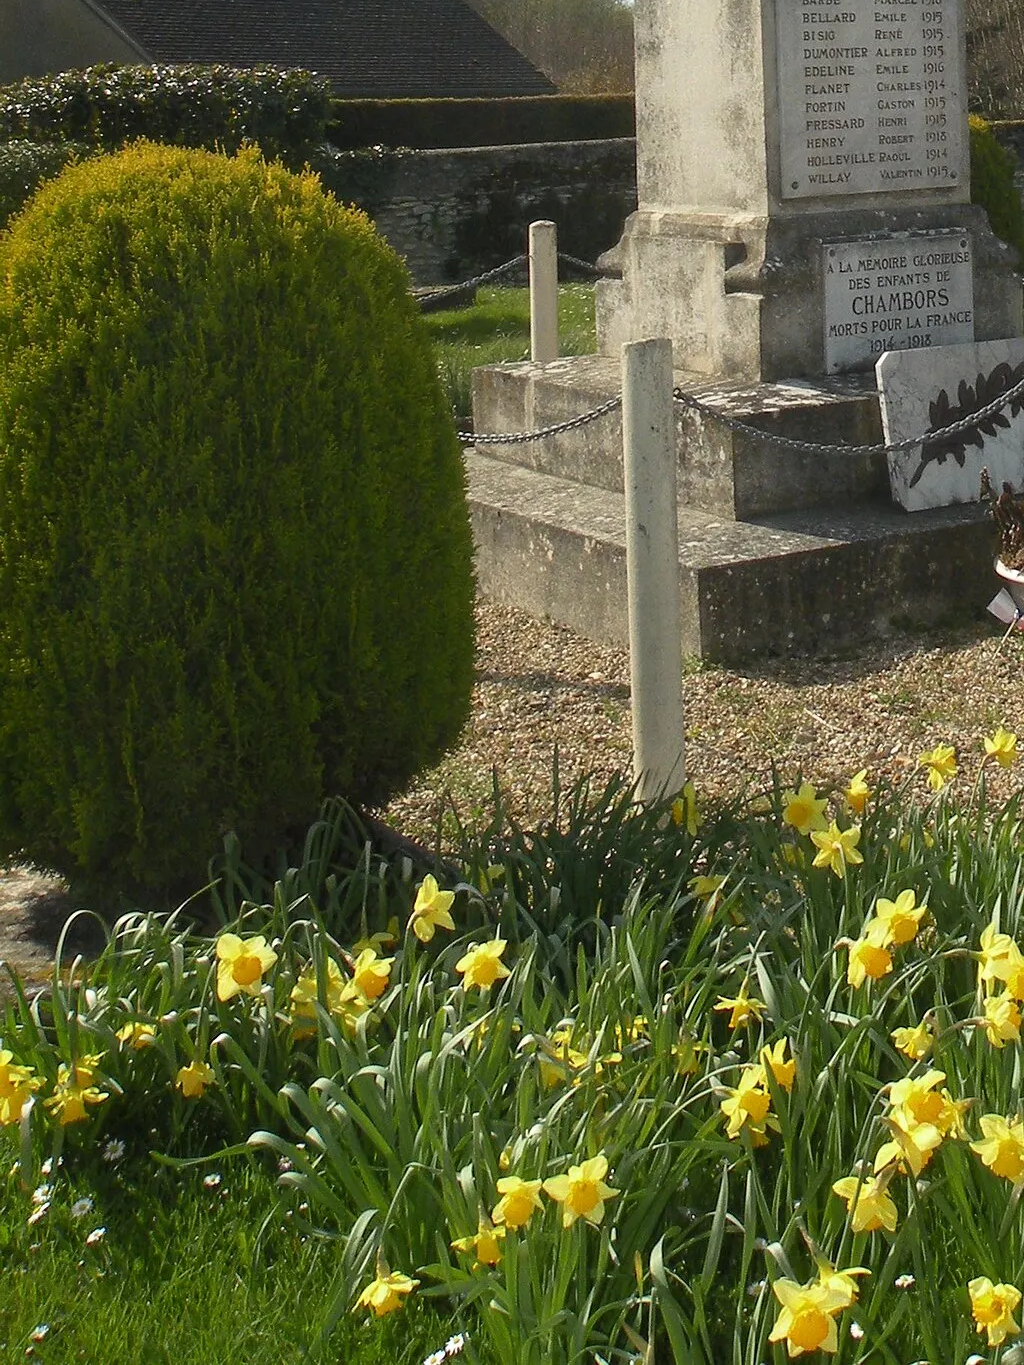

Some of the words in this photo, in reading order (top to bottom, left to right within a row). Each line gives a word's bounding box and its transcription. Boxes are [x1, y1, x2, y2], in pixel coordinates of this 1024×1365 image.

[802, 13, 856, 23] BELLARD
[922, 12, 942, 23] 1915
[922, 29, 943, 40] 1915
[804, 48, 868, 59] DUMONTIER
[923, 46, 944, 57] 1915
[805, 66, 855, 77] EDELINE
[923, 63, 944, 73] 1916
[924, 80, 945, 91] 1914
[806, 102, 846, 113] FORTIN
[924, 97, 945, 109] 1915
[806, 119, 865, 130] FRESSARD
[925, 114, 946, 127] 1915
[807, 137, 846, 148] HENRY
[926, 132, 946, 142] 1918
[808, 153, 875, 166] HOLLEVILLE
[926, 149, 948, 160] 1914
[808, 173, 850, 184] WILLAY
[926, 166, 948, 178] 1915
[827, 264, 834, 274] A
[839, 262, 852, 272] LA
[858, 255, 907, 272] MÉMOIRE
[913, 252, 970, 267] GLORIEUSE
[849, 278, 870, 290] DES
[878, 272, 930, 287] ENFANTS
[937, 271, 950, 282] DE
[852, 288, 949, 315] CHAMBORS
[829, 322, 868, 337] MORTS
[872, 320, 902, 333] POUR
[907, 317, 921, 329] LA
[927, 311, 972, 327] FRANCE
